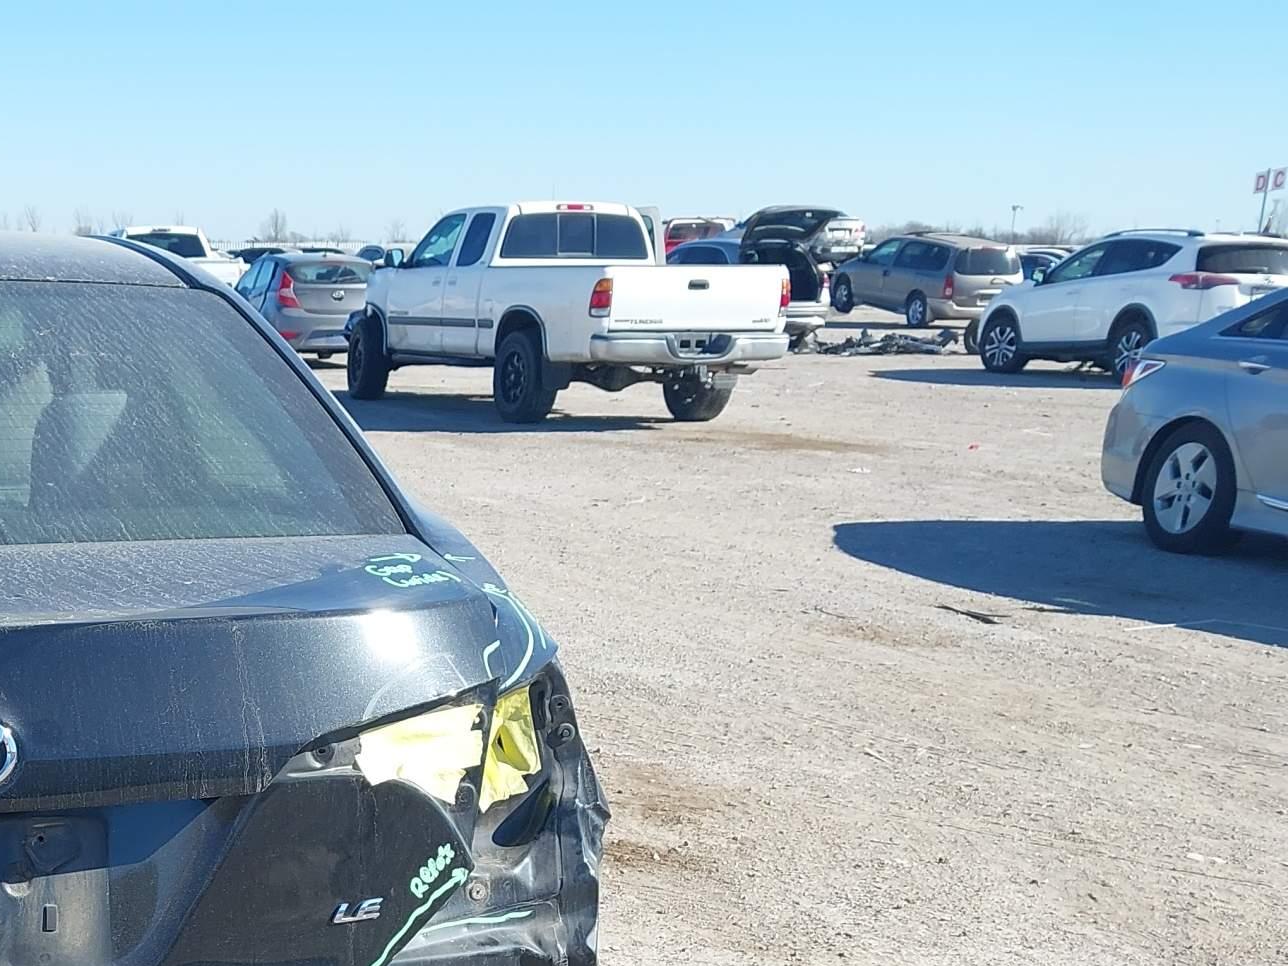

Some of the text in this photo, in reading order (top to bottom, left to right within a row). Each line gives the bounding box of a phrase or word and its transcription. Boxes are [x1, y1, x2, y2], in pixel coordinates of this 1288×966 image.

[1256, 175, 1265, 191] D
[1274, 171, 1284, 187] C
[330, 897, 383, 924] LE
